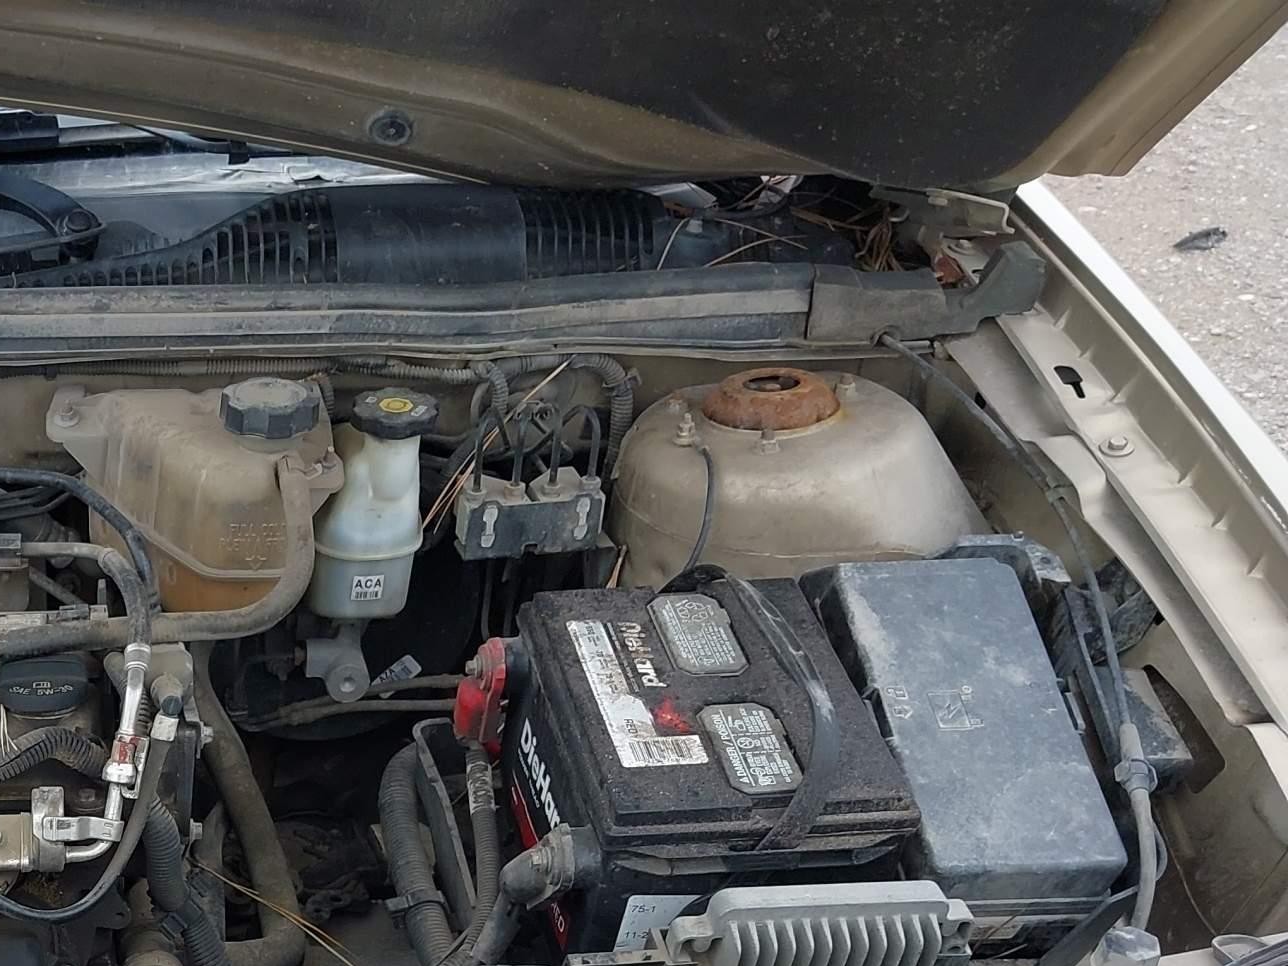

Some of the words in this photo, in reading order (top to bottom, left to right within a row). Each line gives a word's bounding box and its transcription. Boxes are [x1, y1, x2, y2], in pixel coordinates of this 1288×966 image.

[355, 578, 382, 589] ACA
[9, 685, 32, 696] SAE
[36, 684, 73, 696] 5W-30
[711, 714, 731, 740] POISON
[725, 746, 748, 777] DANGER
[520, 717, 560, 832] DieHar
[631, 904, 656, 913] 75-1
